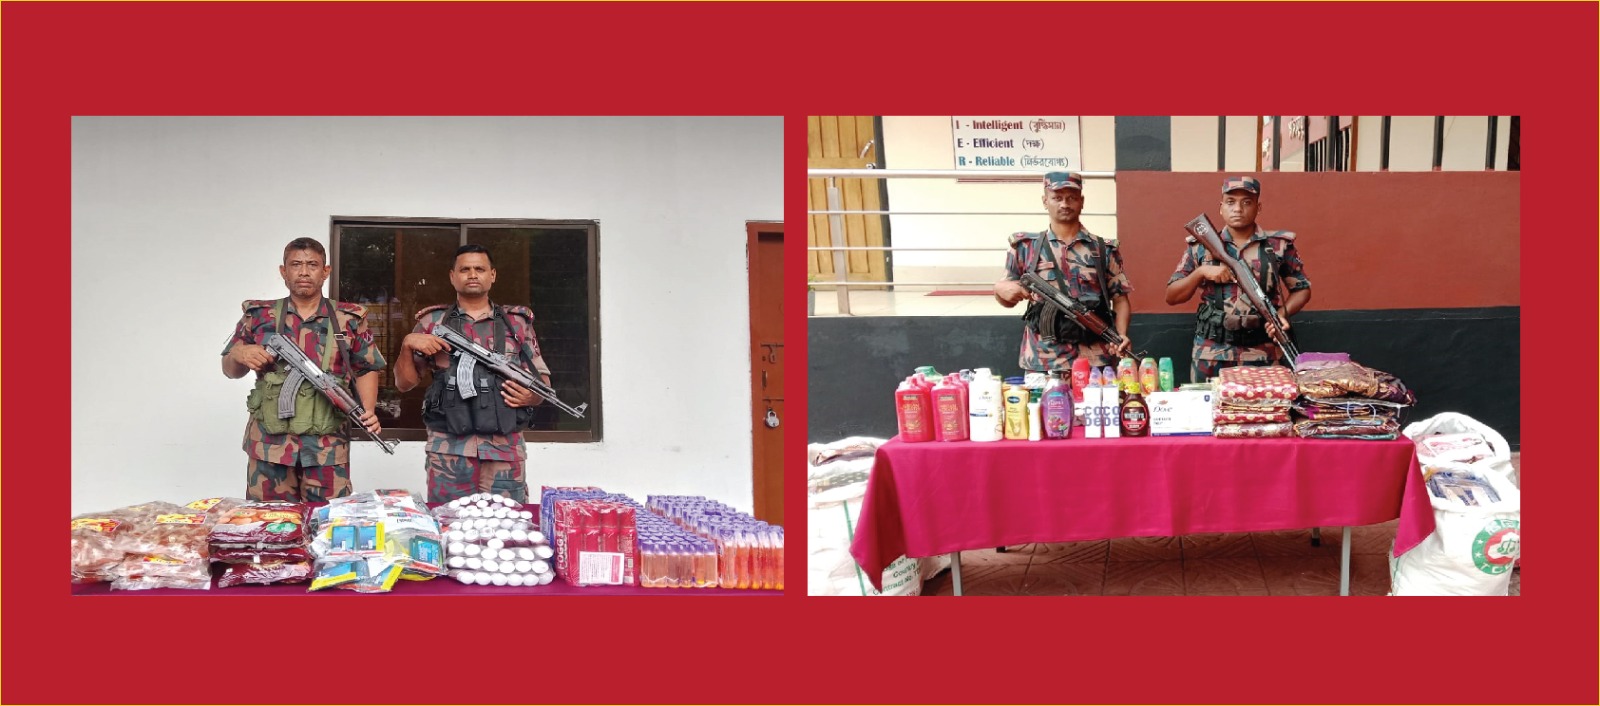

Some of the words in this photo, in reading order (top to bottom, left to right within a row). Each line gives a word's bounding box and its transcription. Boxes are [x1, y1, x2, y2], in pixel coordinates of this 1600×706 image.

[972, 119, 1024, 132] Intelligent
[957, 138, 964, 148] E
[973, 138, 1014, 149] Efficient
[958, 156, 967, 167] R
[975, 156, 1015, 167] Reliable
